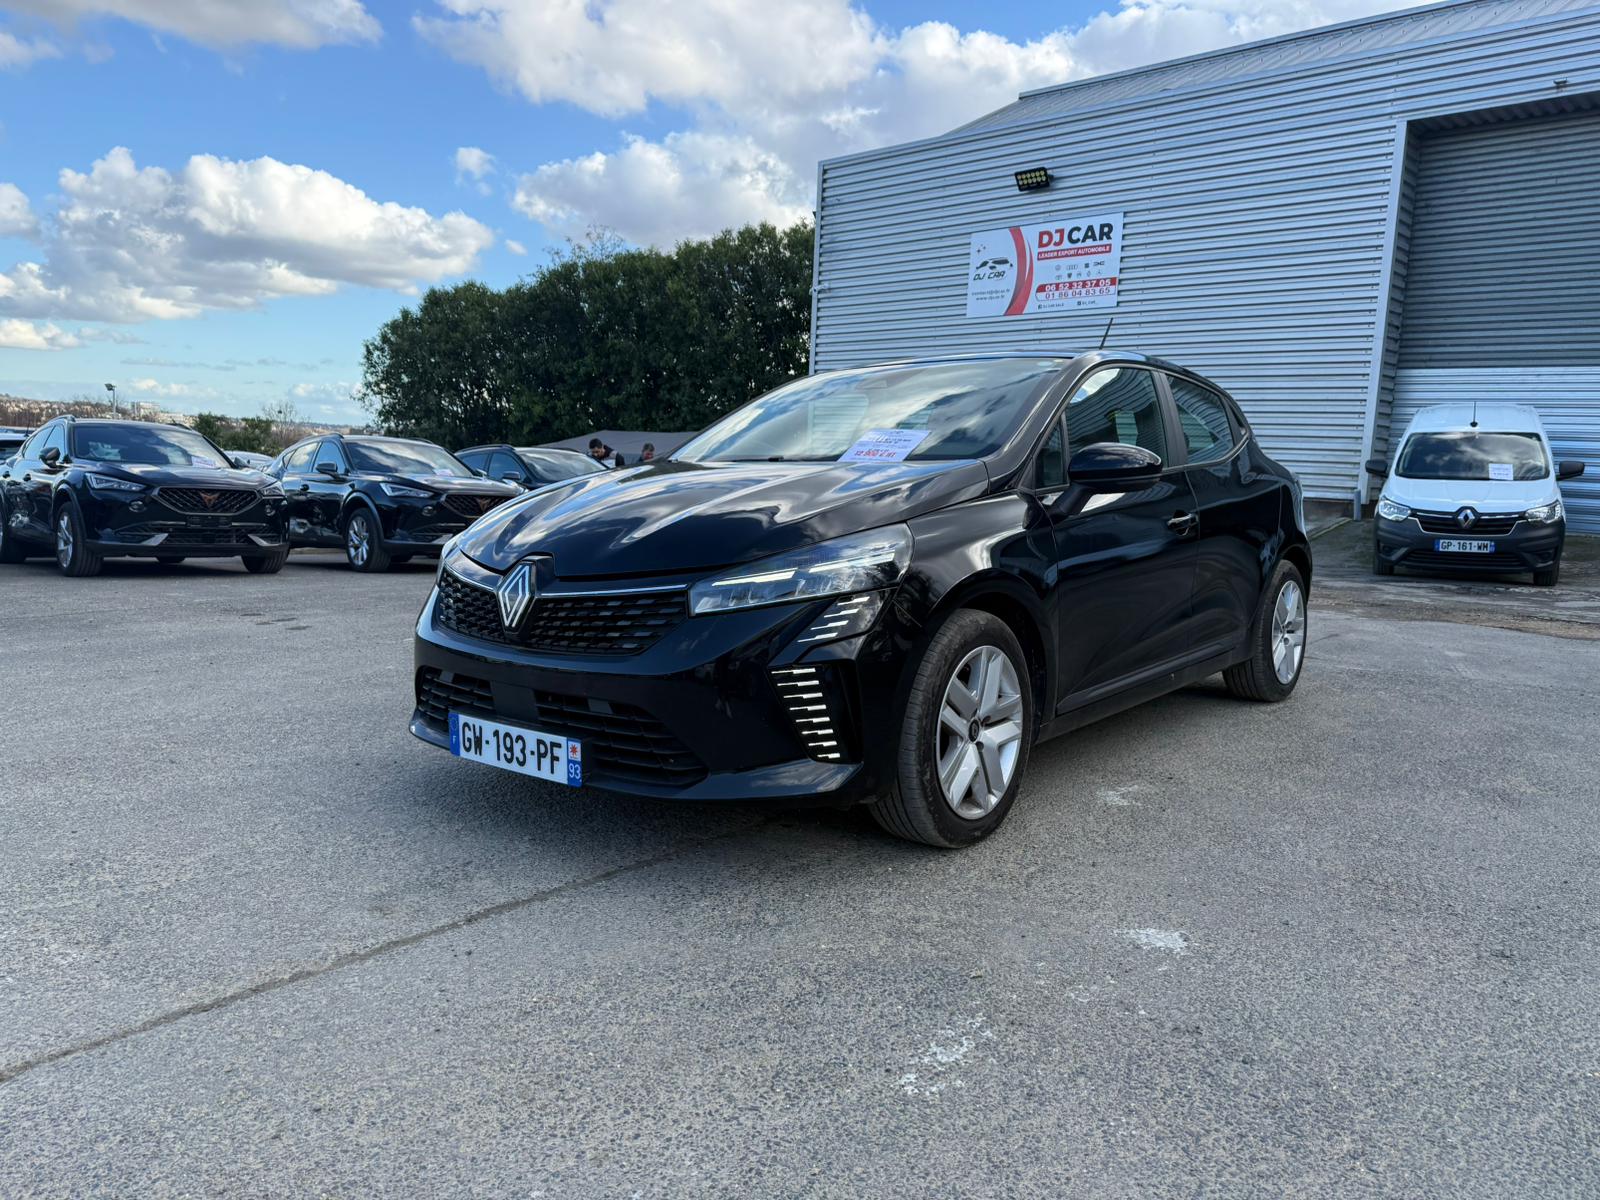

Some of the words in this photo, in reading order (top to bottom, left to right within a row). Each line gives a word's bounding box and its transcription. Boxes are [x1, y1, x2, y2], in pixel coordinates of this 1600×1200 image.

[1038, 251, 1058, 259] LEADER
[1058, 249, 1078, 257] EXPORT
[1078, 246, 1110, 255] AUTOMOBILE
[973, 273, 986, 281] DJ
[988, 270, 1006, 279] CAR
[461, 721, 562, 774] GW-193-PF
[568, 763, 581, 779] 93
